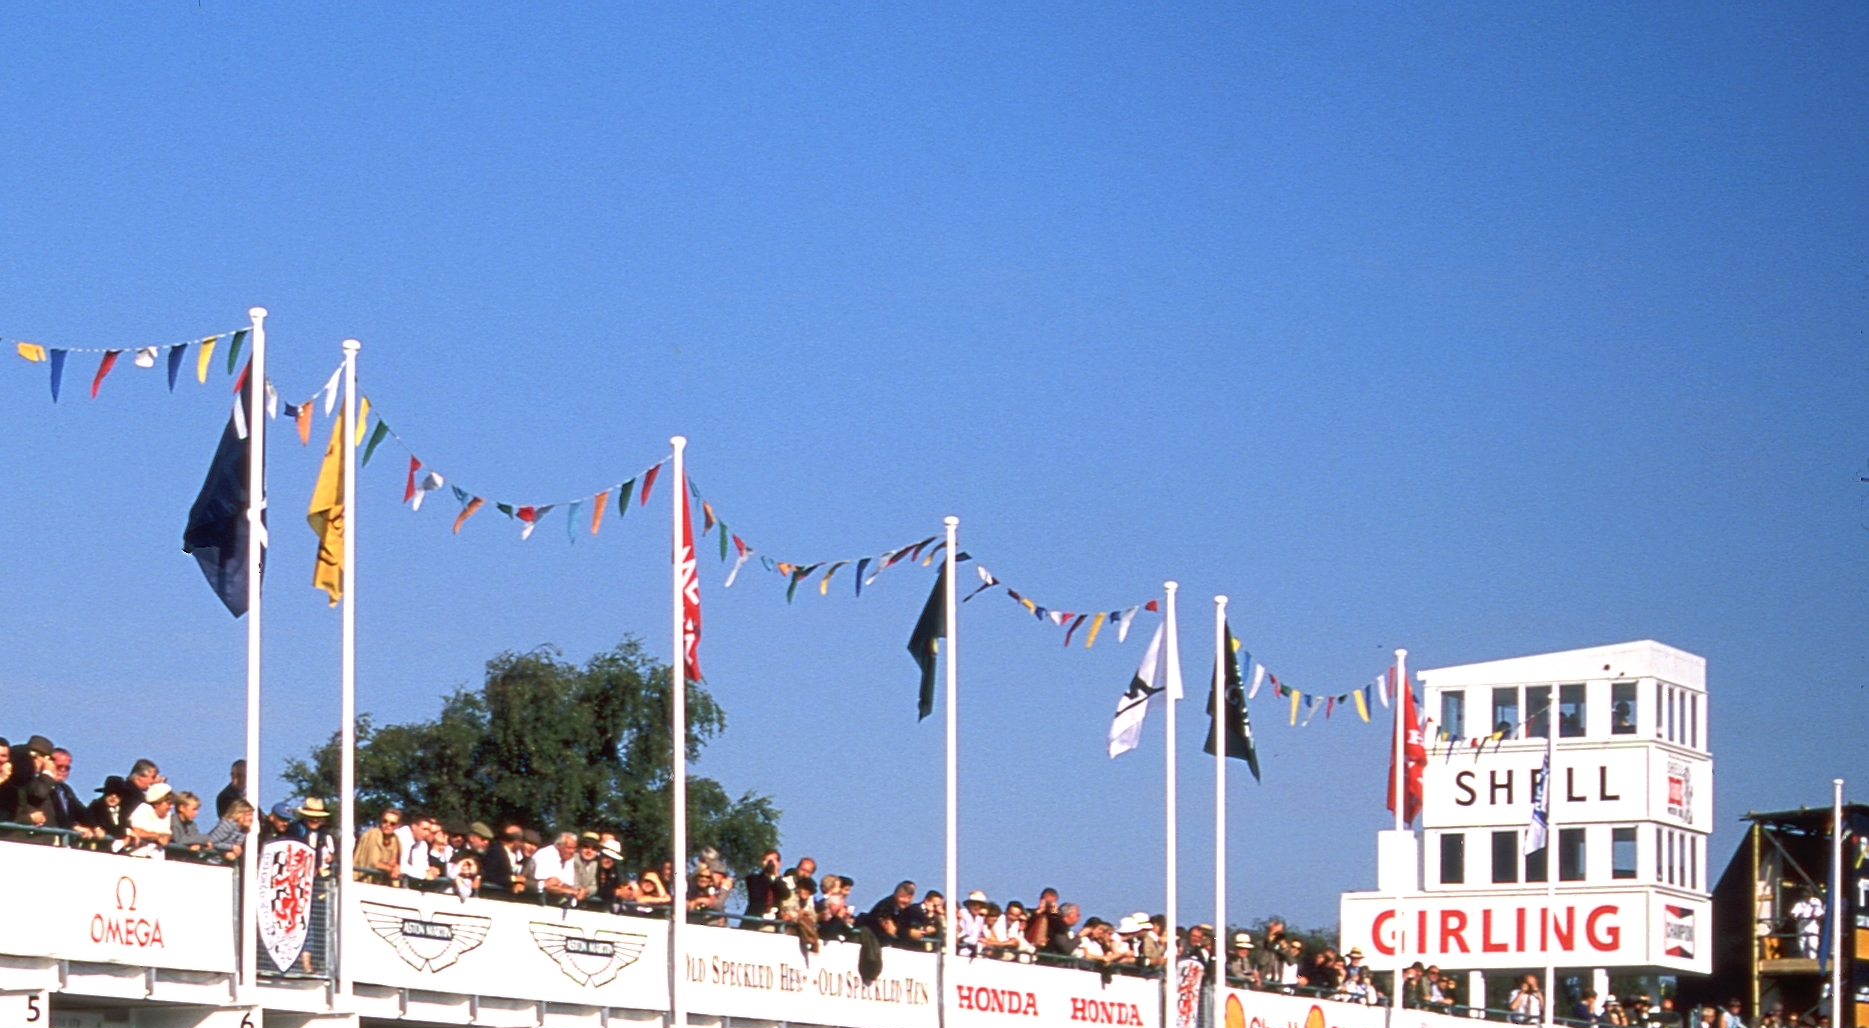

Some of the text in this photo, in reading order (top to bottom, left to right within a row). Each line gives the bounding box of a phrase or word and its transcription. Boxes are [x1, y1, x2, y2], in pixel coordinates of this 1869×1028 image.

[90, 913, 164, 948] OMEGA
[1371, 905, 1621, 956] GIRLING
[26, 995, 40, 1022] 5
[956, 985, 1039, 1017] HONDA
[1070, 997, 1144, 1027] HONDA
